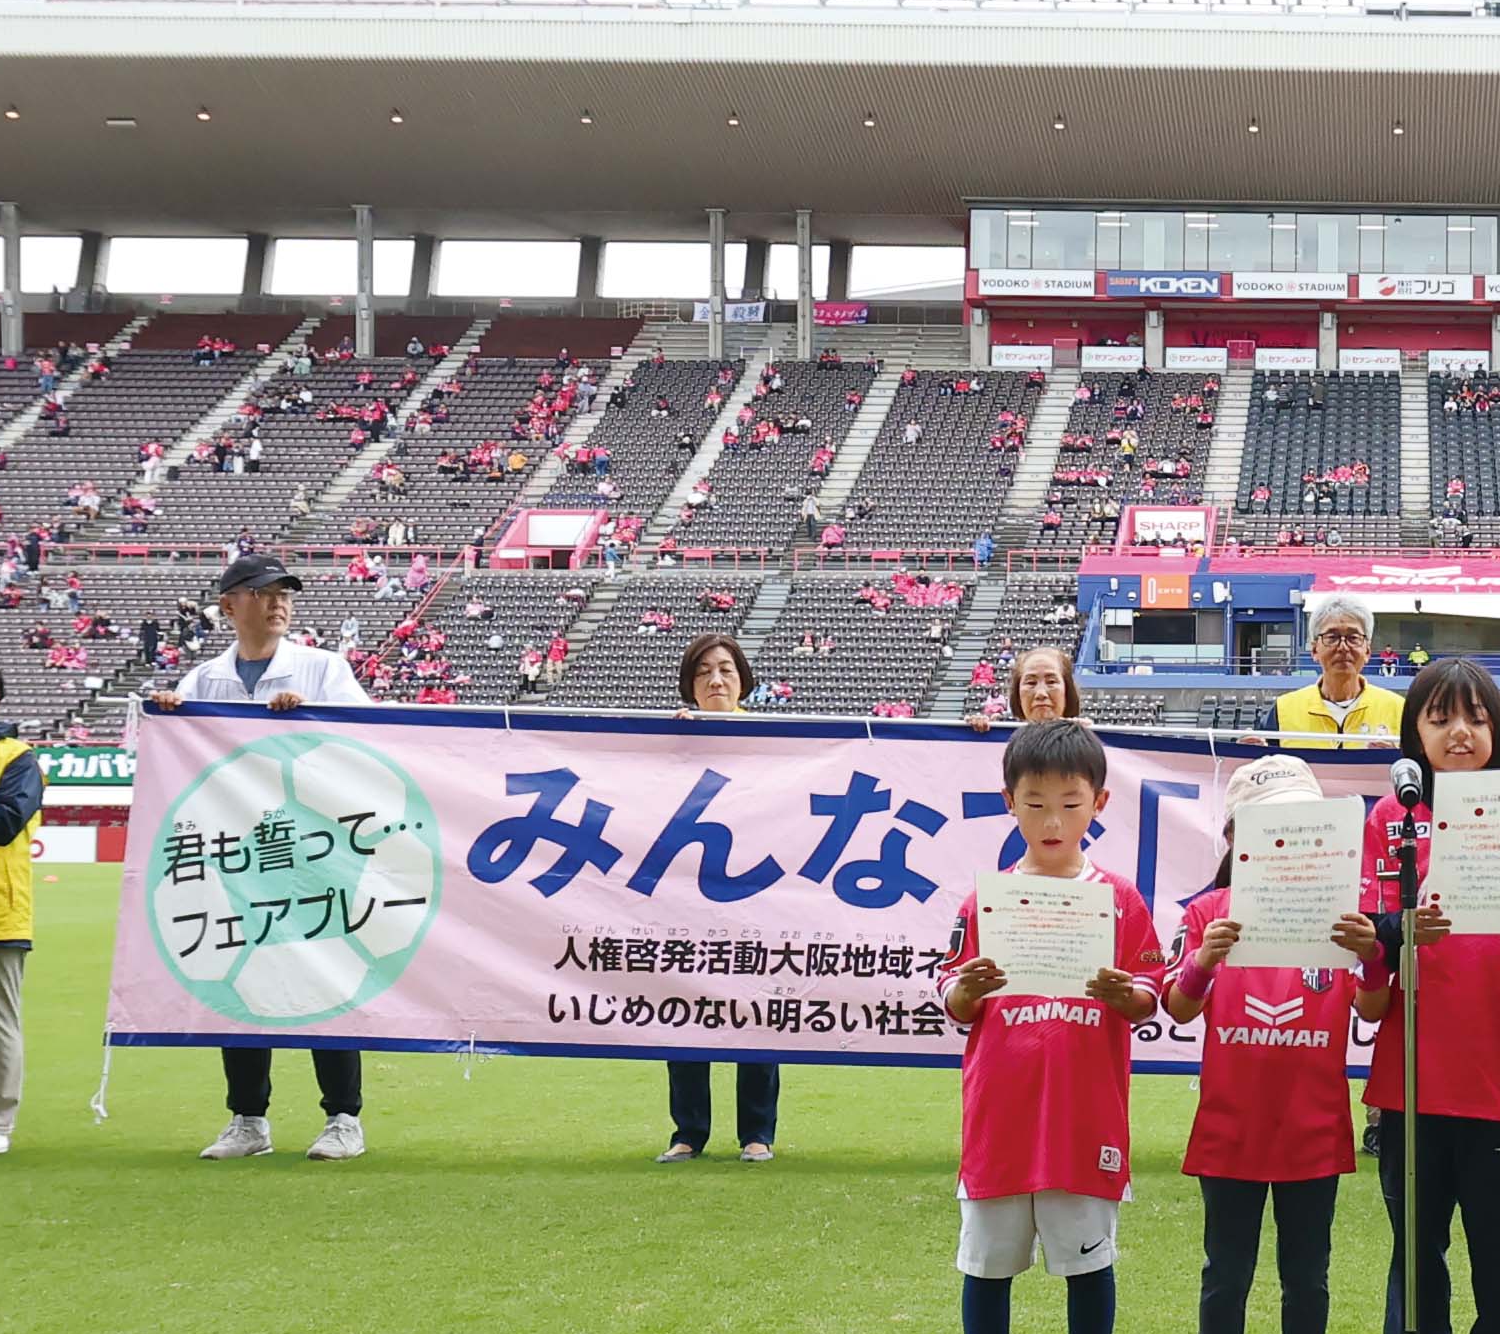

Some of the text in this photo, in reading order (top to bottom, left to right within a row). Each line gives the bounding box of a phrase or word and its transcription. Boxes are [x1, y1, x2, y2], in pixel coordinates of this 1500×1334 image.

[980, 279, 1093, 290] YODOKO STADIUM
[1235, 281, 1346, 293] YODOKO STADIUM
[1139, 521, 1200, 531] SHARP
[172, 887, 427, 959] フェアプレー
[1215, 1025, 1330, 1048] YANMAR
